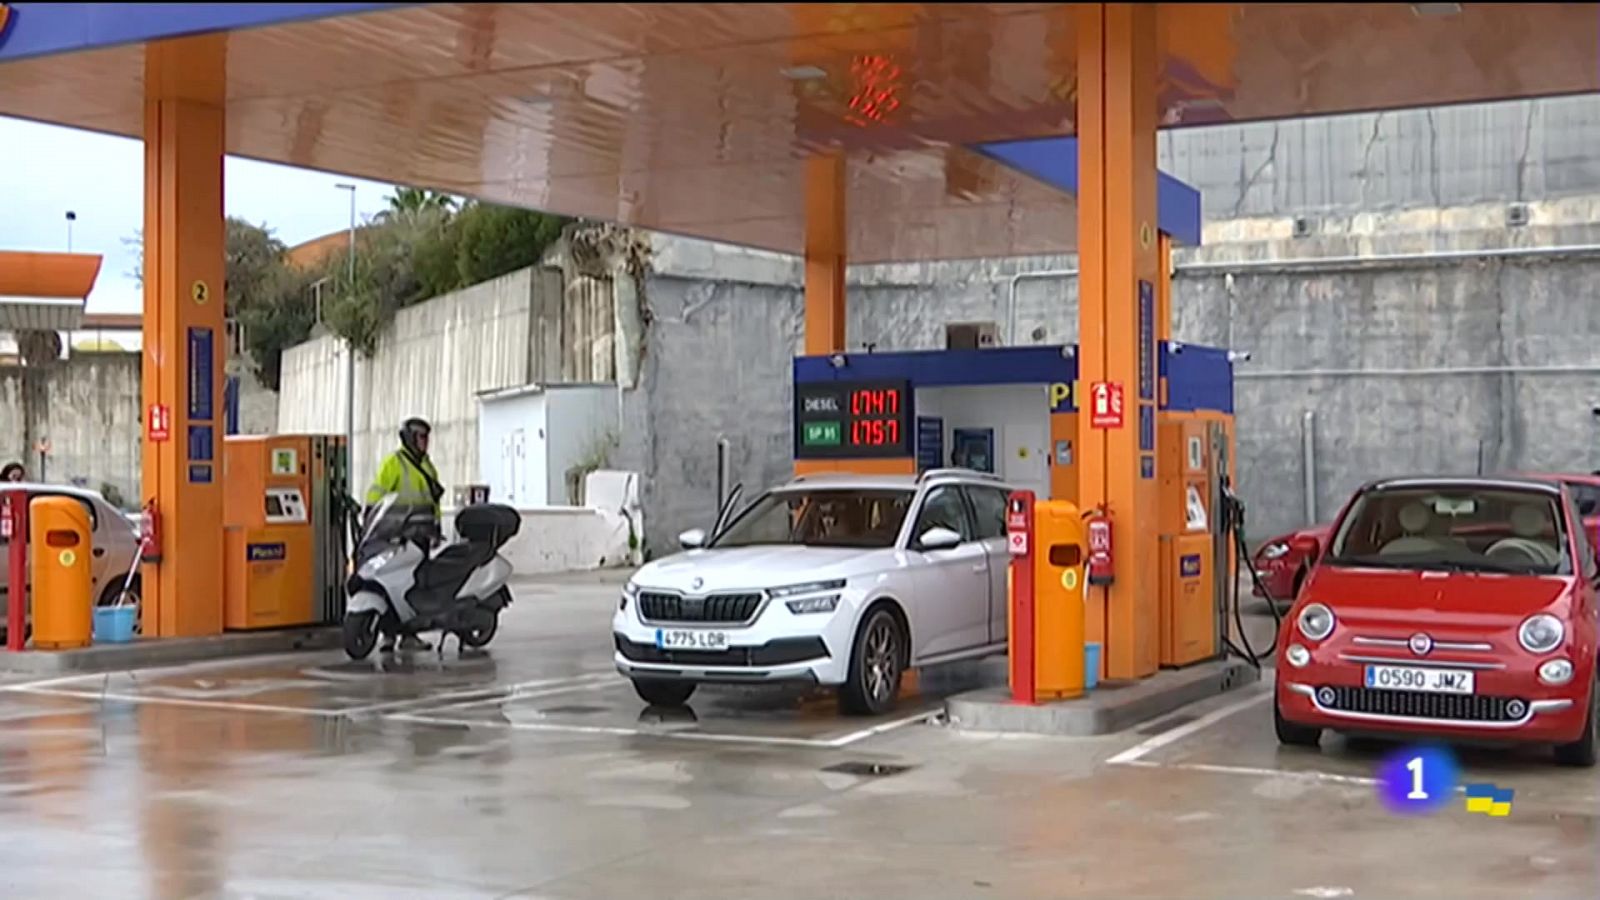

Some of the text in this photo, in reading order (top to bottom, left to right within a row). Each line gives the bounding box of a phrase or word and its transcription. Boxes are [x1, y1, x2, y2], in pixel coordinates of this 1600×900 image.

[197, 284, 204, 300] 2
[804, 397, 838, 411] DIESEL
[665, 631, 697, 646] 4775
[1379, 668, 1467, 690] 0590 JMZ
